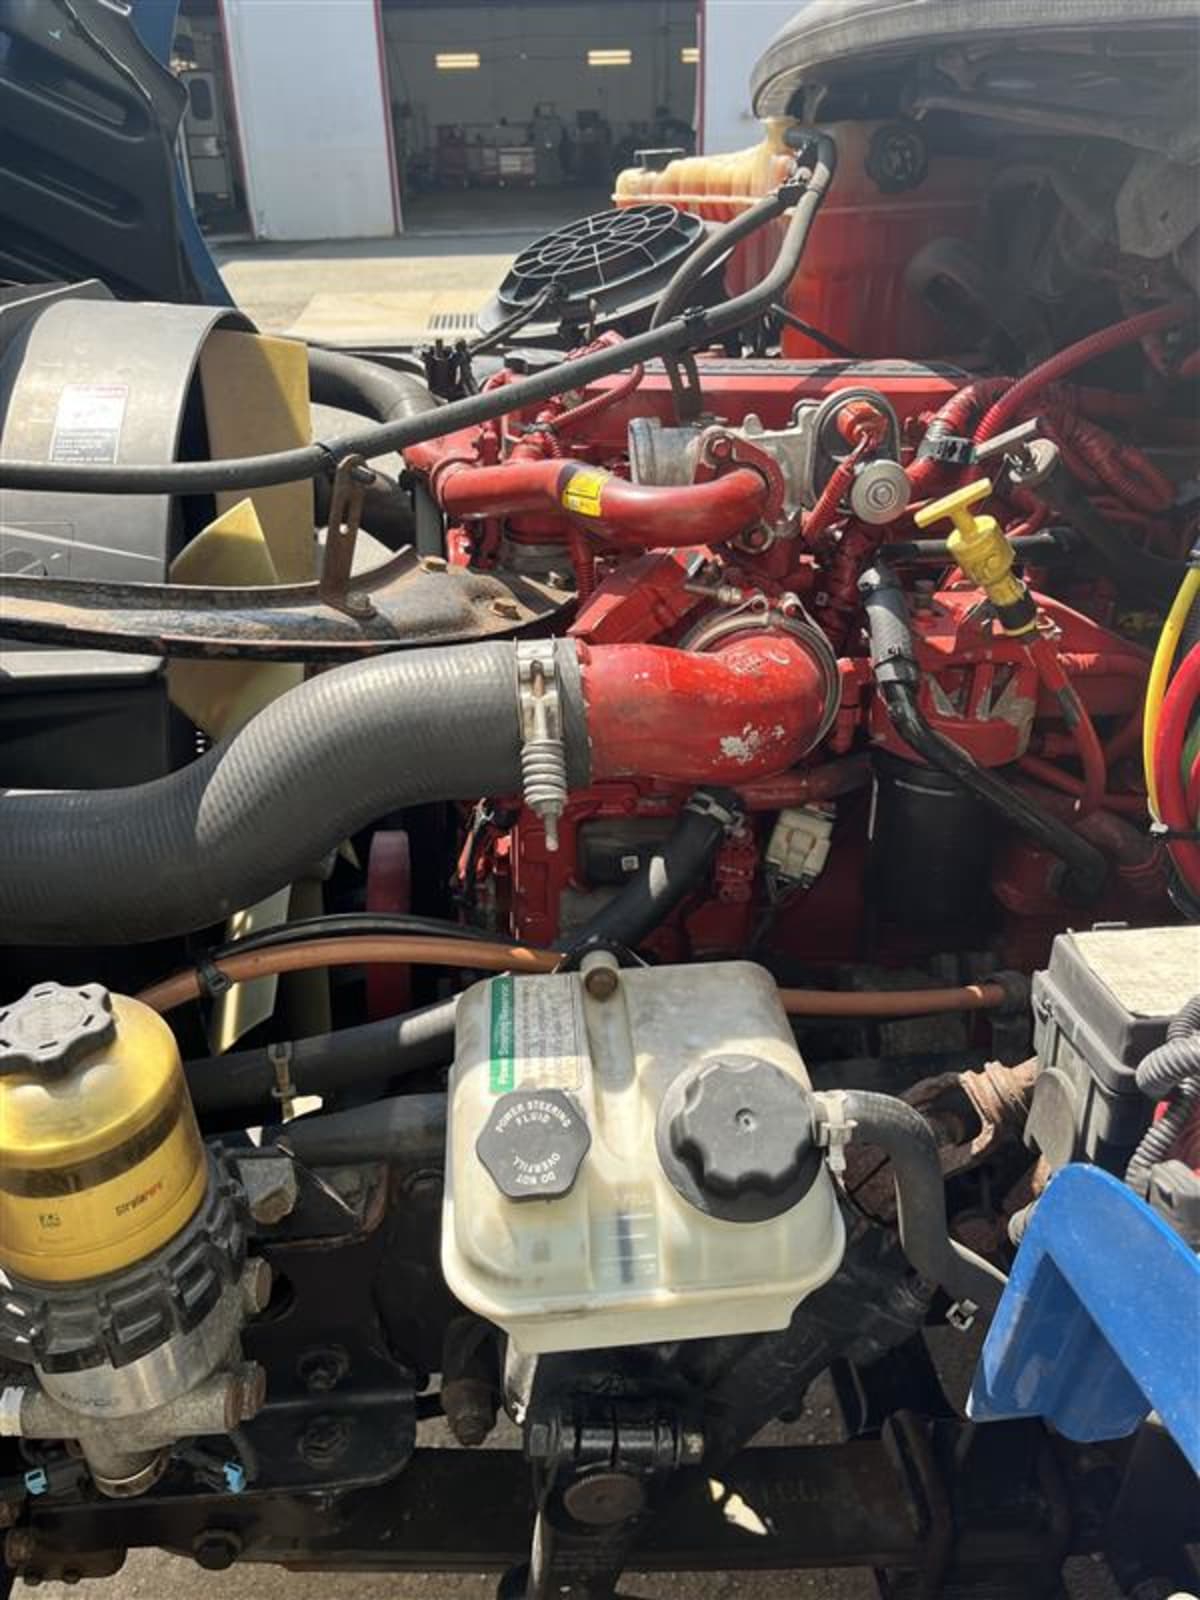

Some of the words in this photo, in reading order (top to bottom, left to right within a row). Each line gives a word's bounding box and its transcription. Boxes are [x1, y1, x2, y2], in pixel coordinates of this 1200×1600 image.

[495, 1103, 525, 1133] POWER
[527, 1100, 571, 1128] STEERING
[515, 1112, 551, 1126] FLUID
[513, 1153, 560, 1173] OVERFILL
[516, 1174, 537, 1185] NOT
[541, 1171, 556, 1183] DO
